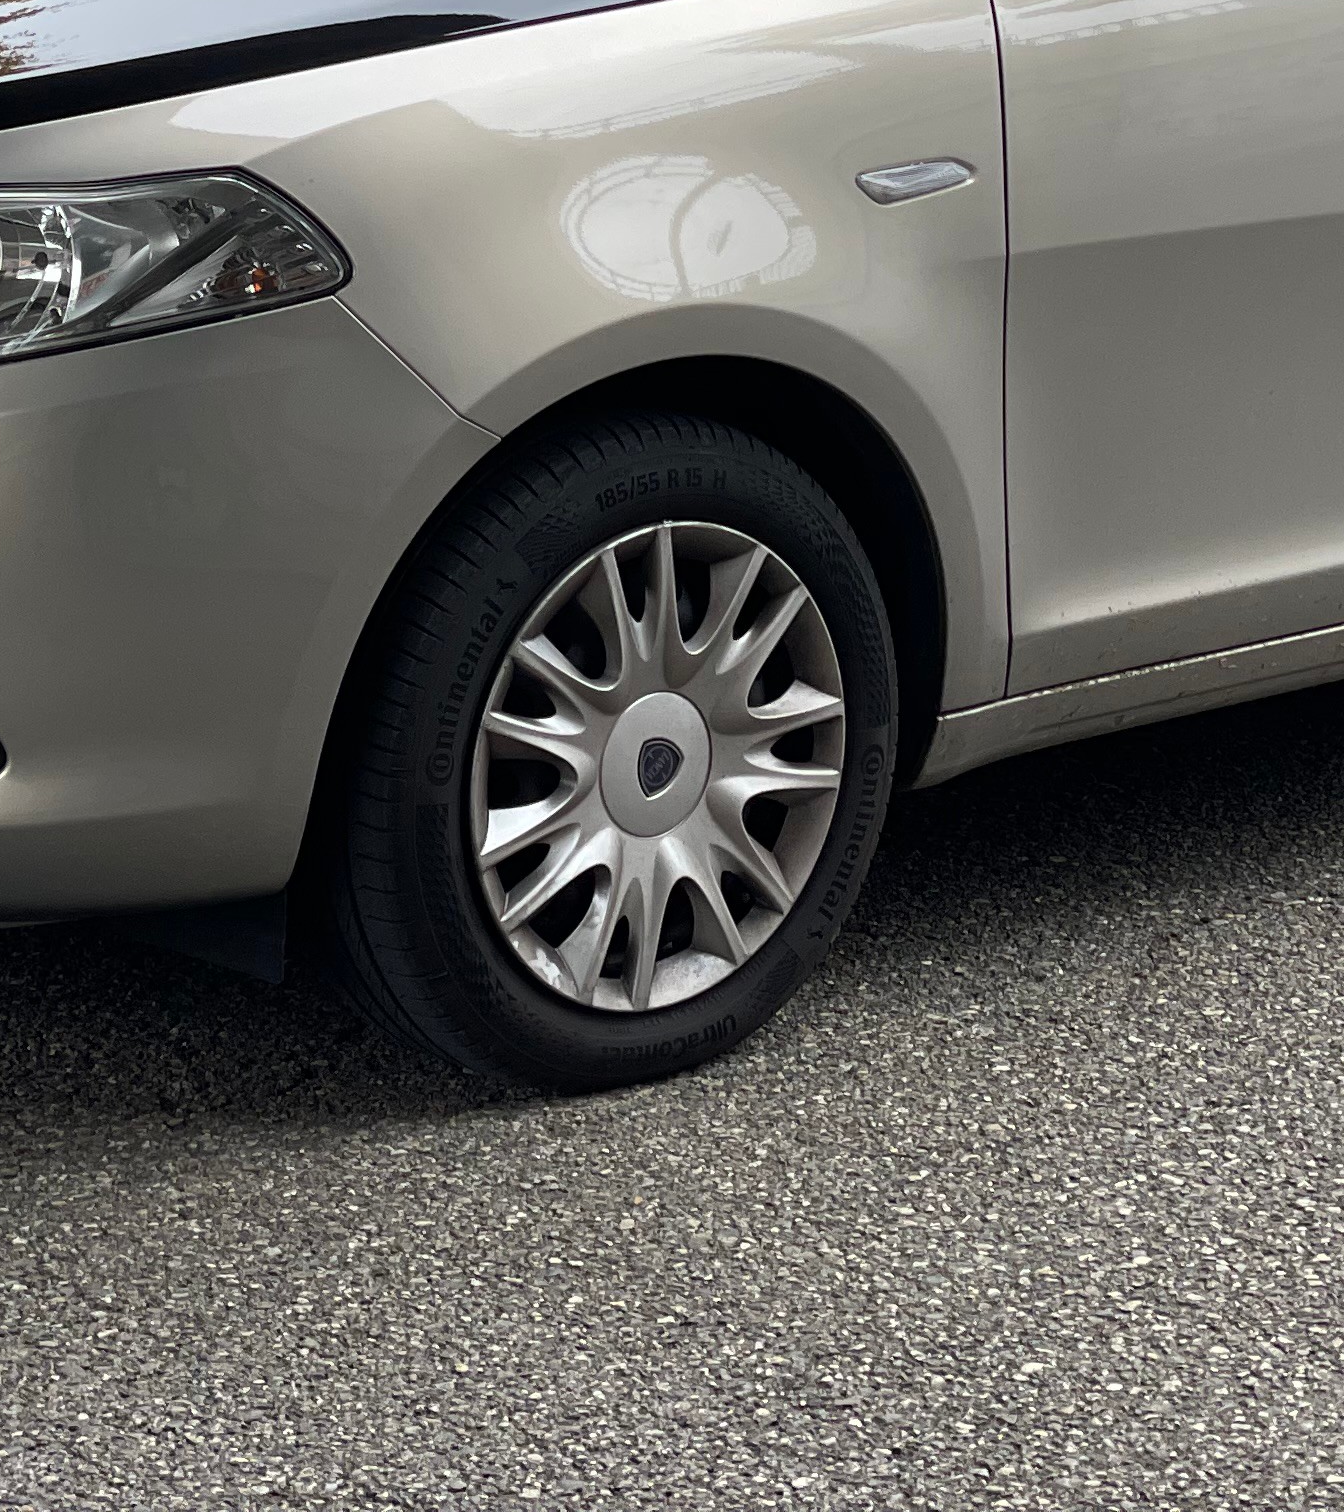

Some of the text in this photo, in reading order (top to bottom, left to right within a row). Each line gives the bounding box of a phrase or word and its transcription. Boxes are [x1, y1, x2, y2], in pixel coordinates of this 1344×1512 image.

[594, 467, 728, 512] 185/55 R 15 H
[426, 595, 504, 787] Continental
